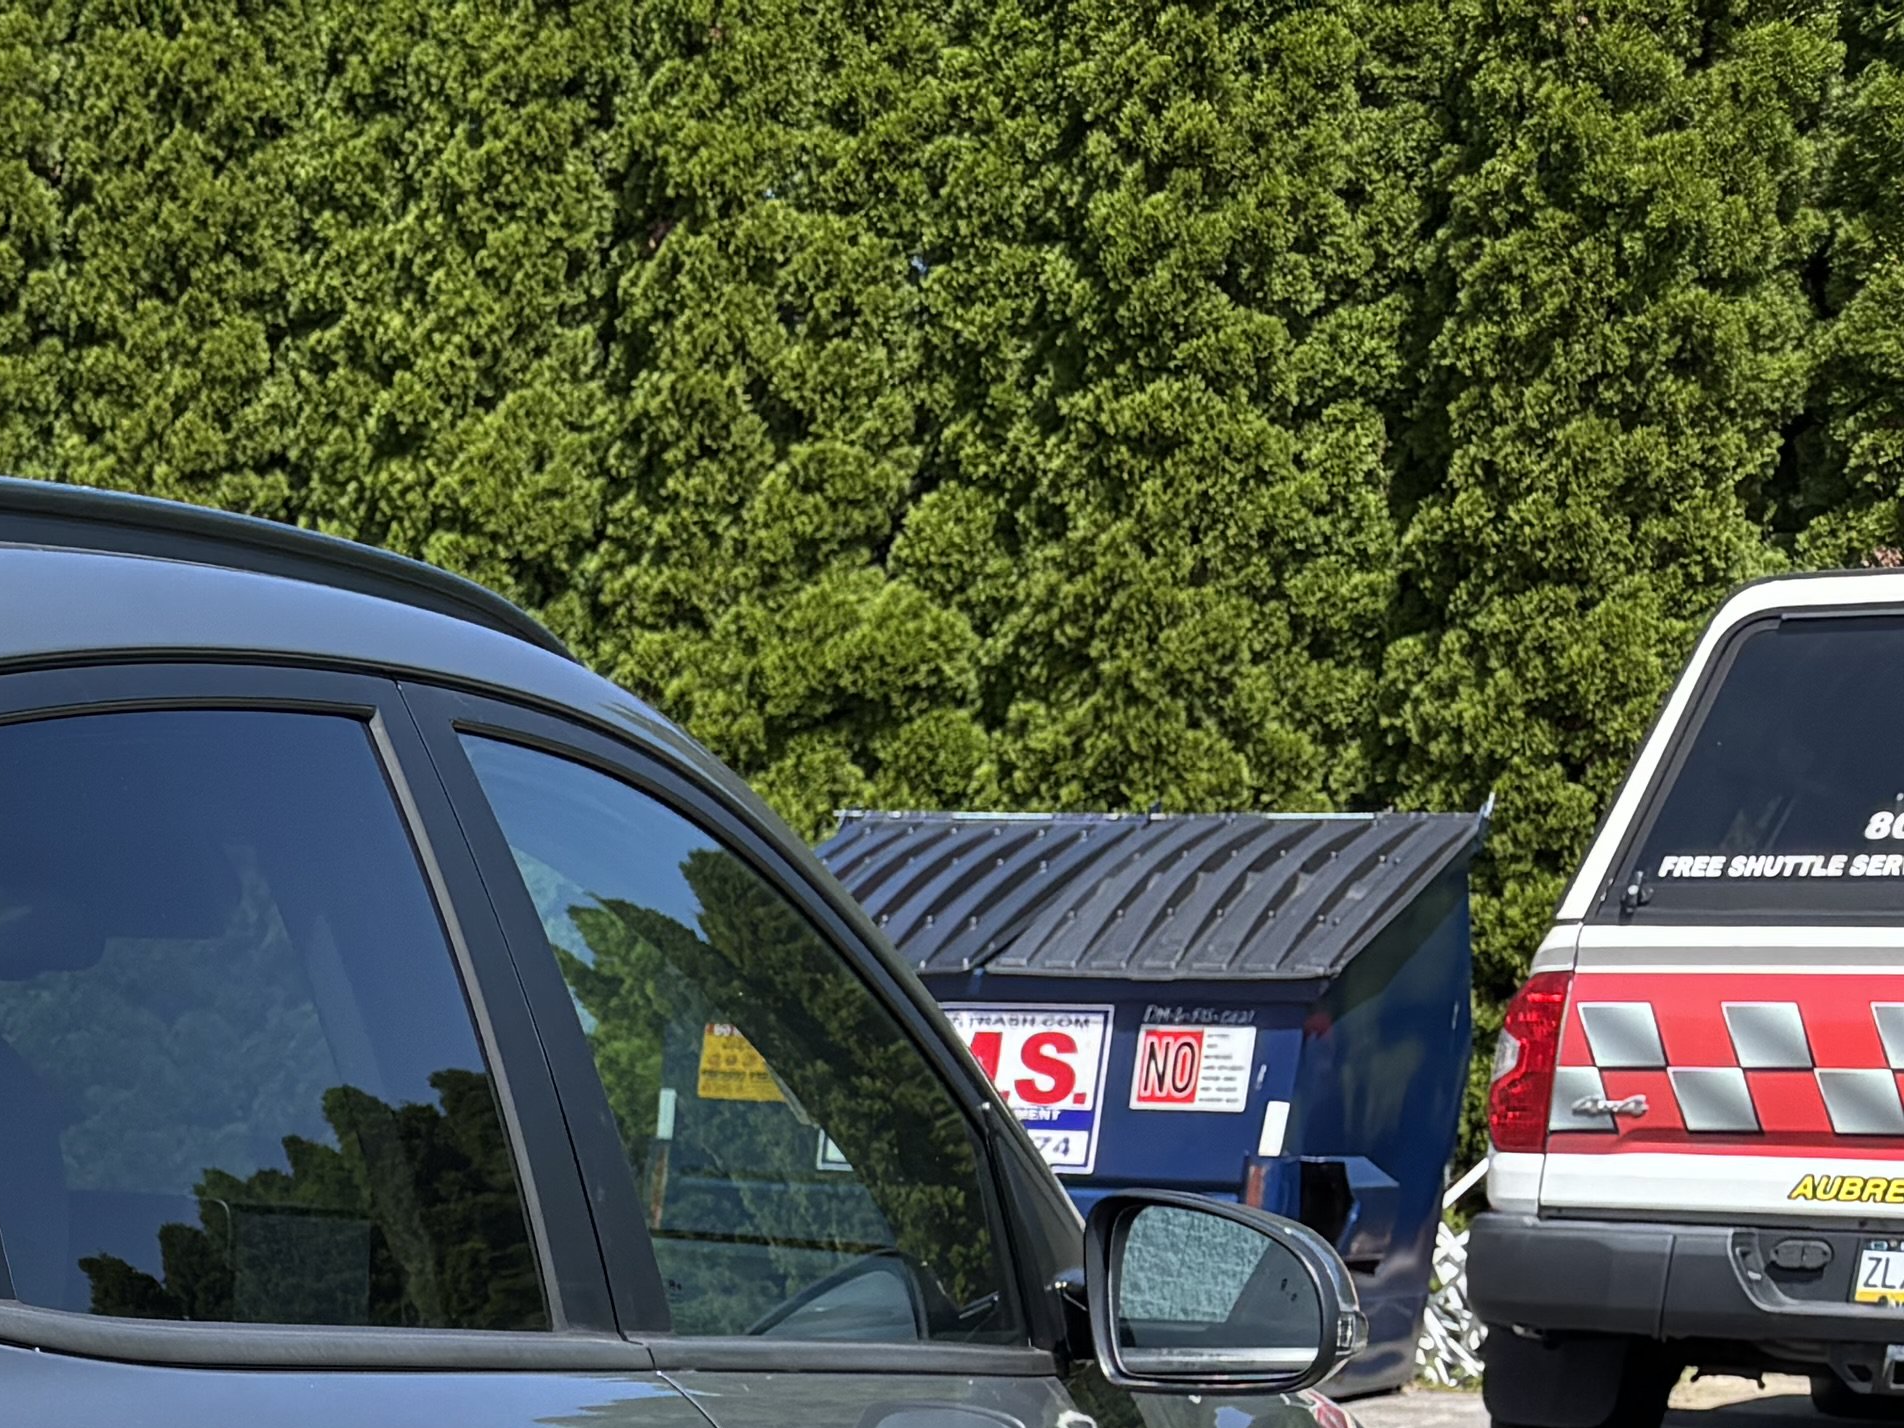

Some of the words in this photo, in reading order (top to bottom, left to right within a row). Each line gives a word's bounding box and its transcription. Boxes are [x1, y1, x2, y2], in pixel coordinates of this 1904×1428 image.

[1658, 854, 1727, 878] FREE
[1727, 854, 1848, 878] SHUTTLE
[1848, 853, 1904, 877] SER
[1141, 1038, 1198, 1095] NO
[1786, 1173, 1904, 1204] AUBRE
[1863, 1256, 1904, 1290] ZL
